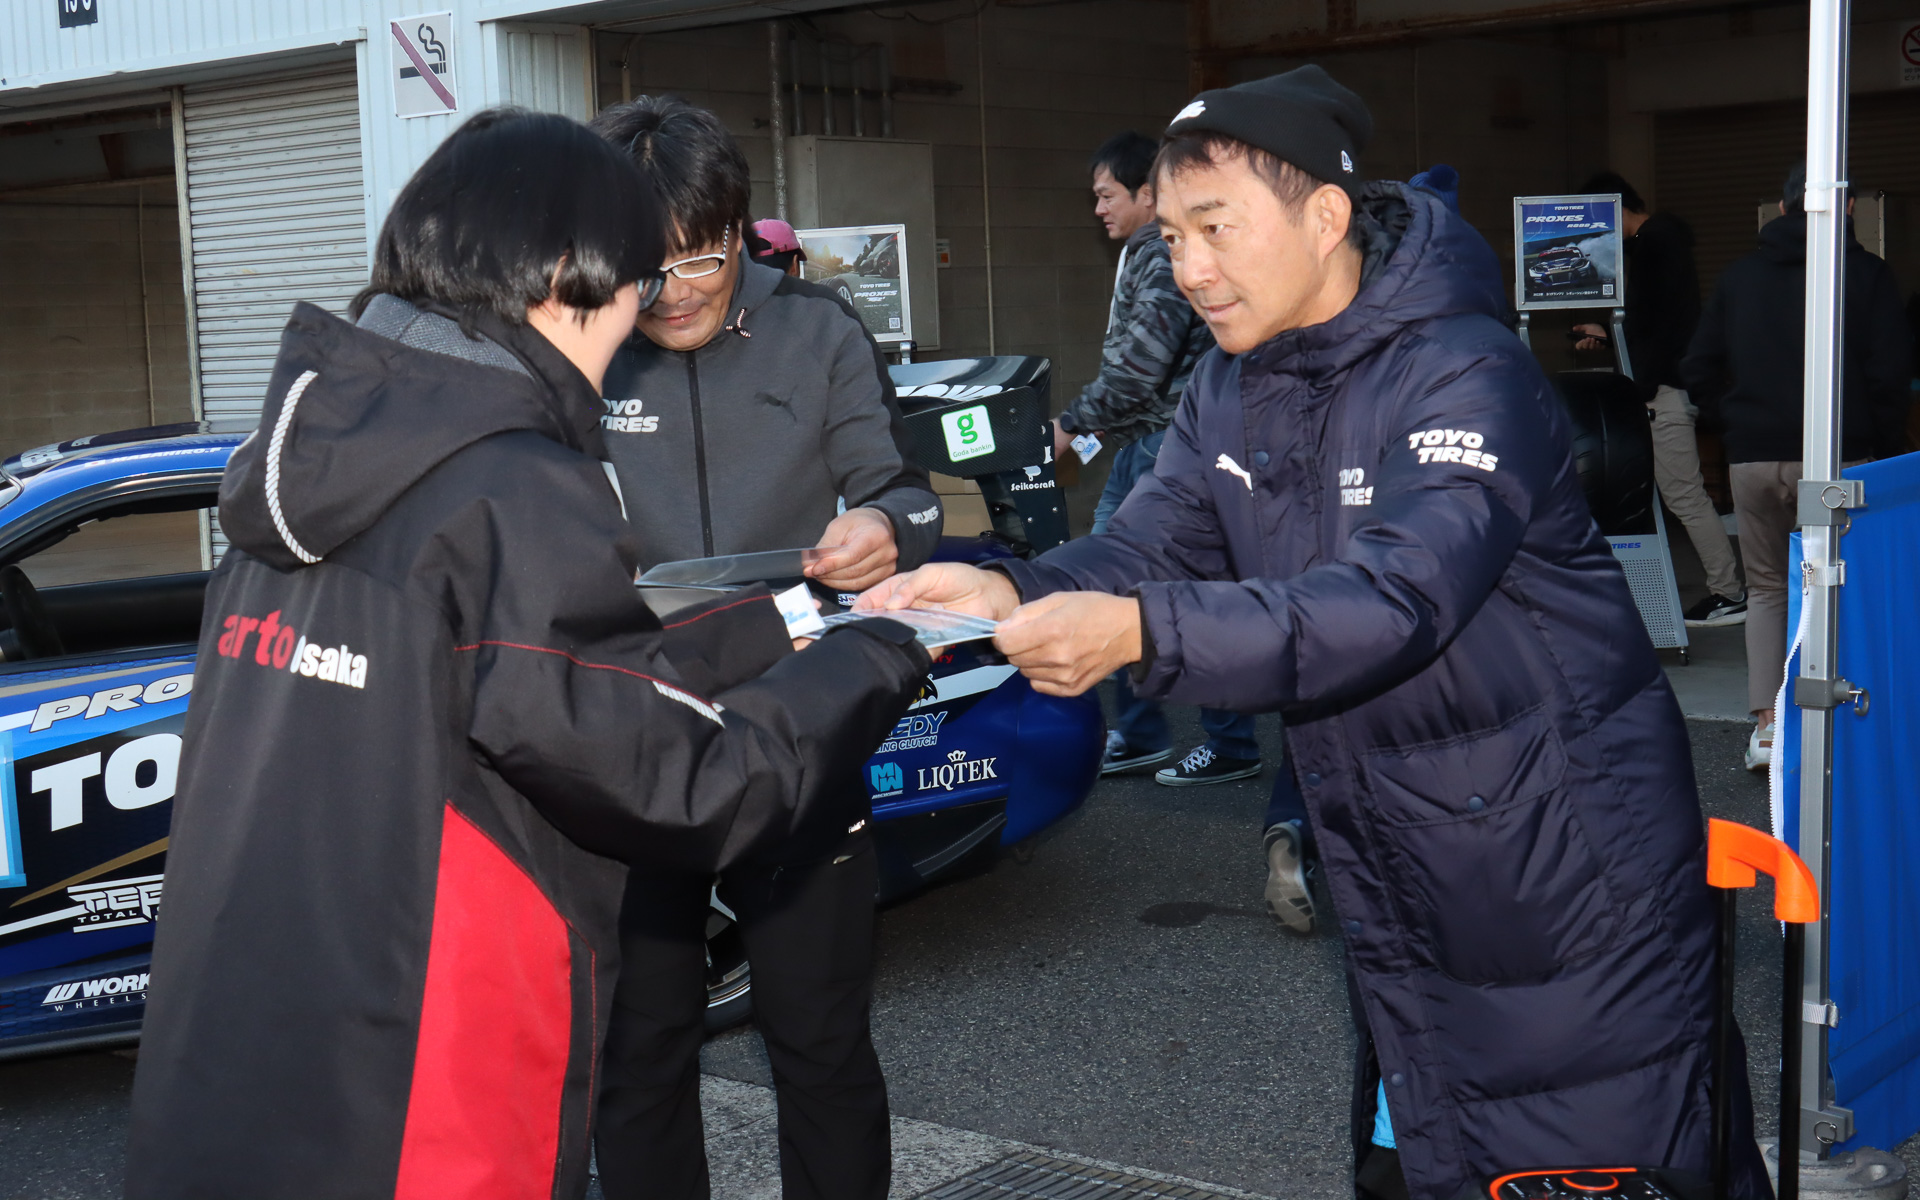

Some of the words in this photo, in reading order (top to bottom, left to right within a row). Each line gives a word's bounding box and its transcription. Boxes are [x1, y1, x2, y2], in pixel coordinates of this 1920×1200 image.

[1525, 214, 1585, 223] PROXES
[854, 290, 898, 298] PROXES
[1408, 429, 1484, 450] TOYO
[952, 450, 970, 458] Goda
[970, 443, 992, 454] bankin
[1417, 446, 1499, 472] TIRES
[1010, 479, 1055, 492] Seikocraft
[898, 735, 938, 749] CLUTCH
[917, 757, 998, 791] LIQTEK
[77, 910, 138, 923] TOTAL
[54, 993, 148, 1012] WHEELS
